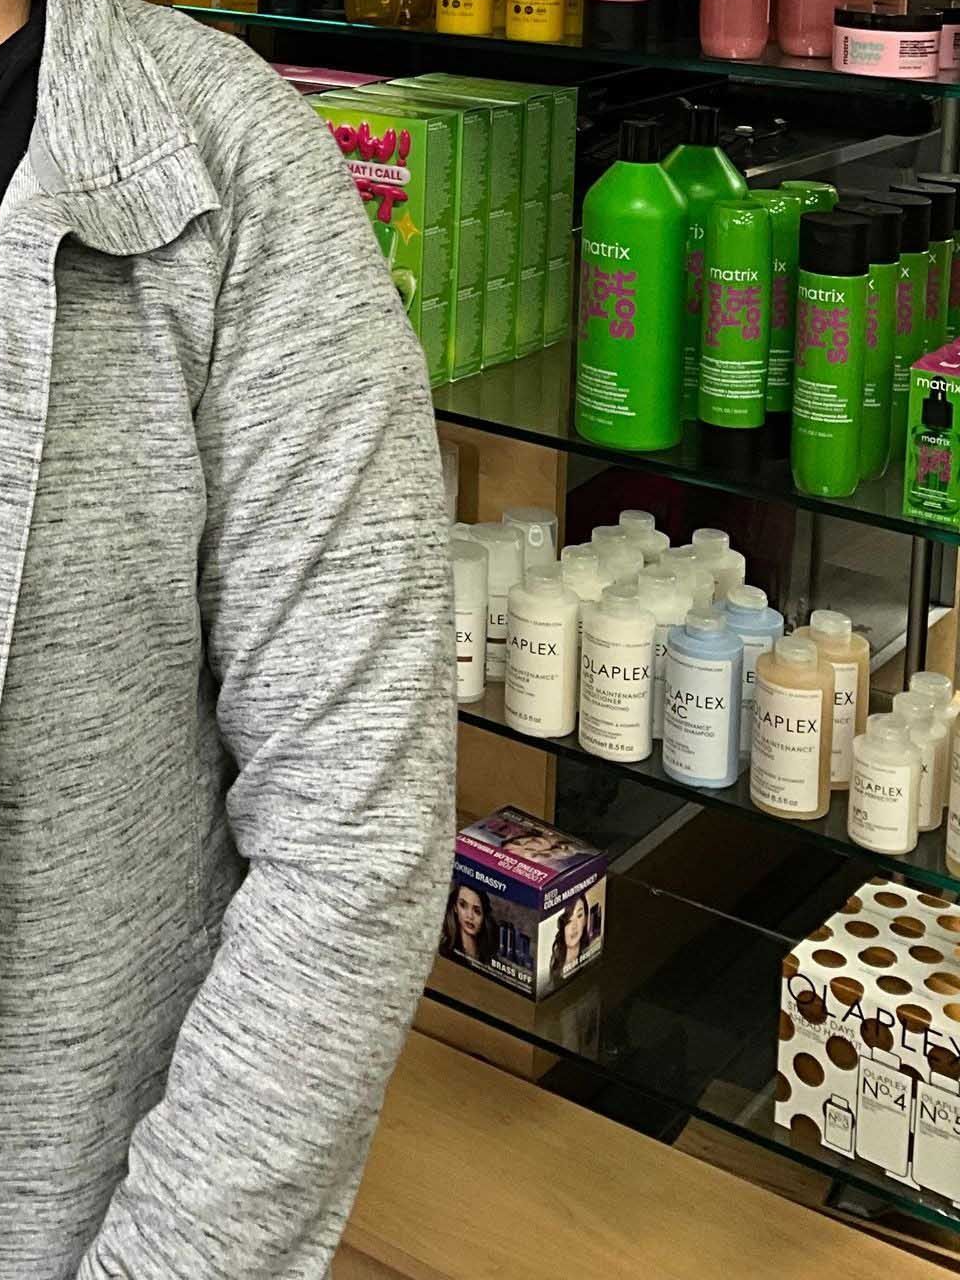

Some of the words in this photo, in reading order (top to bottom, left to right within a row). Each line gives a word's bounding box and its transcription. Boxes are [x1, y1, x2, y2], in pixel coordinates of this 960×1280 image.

[842, 35, 850, 66] matrix
[375, 167, 403, 181] CALL
[709, 266, 759, 283] matrix
[609, 269, 637, 340] Soft
[798, 285, 846, 304] matrix
[582, 654, 650, 681] OLAPLEX
[854, 775, 903, 797] OLAPLEX
[475, 871, 508, 892] BRASSY?
[491, 959, 516, 979] BRASS
[517, 971, 532, 984] OFF
[863, 1067, 908, 1092] OLAPLEX
[893, 1093, 907, 1112] 4
